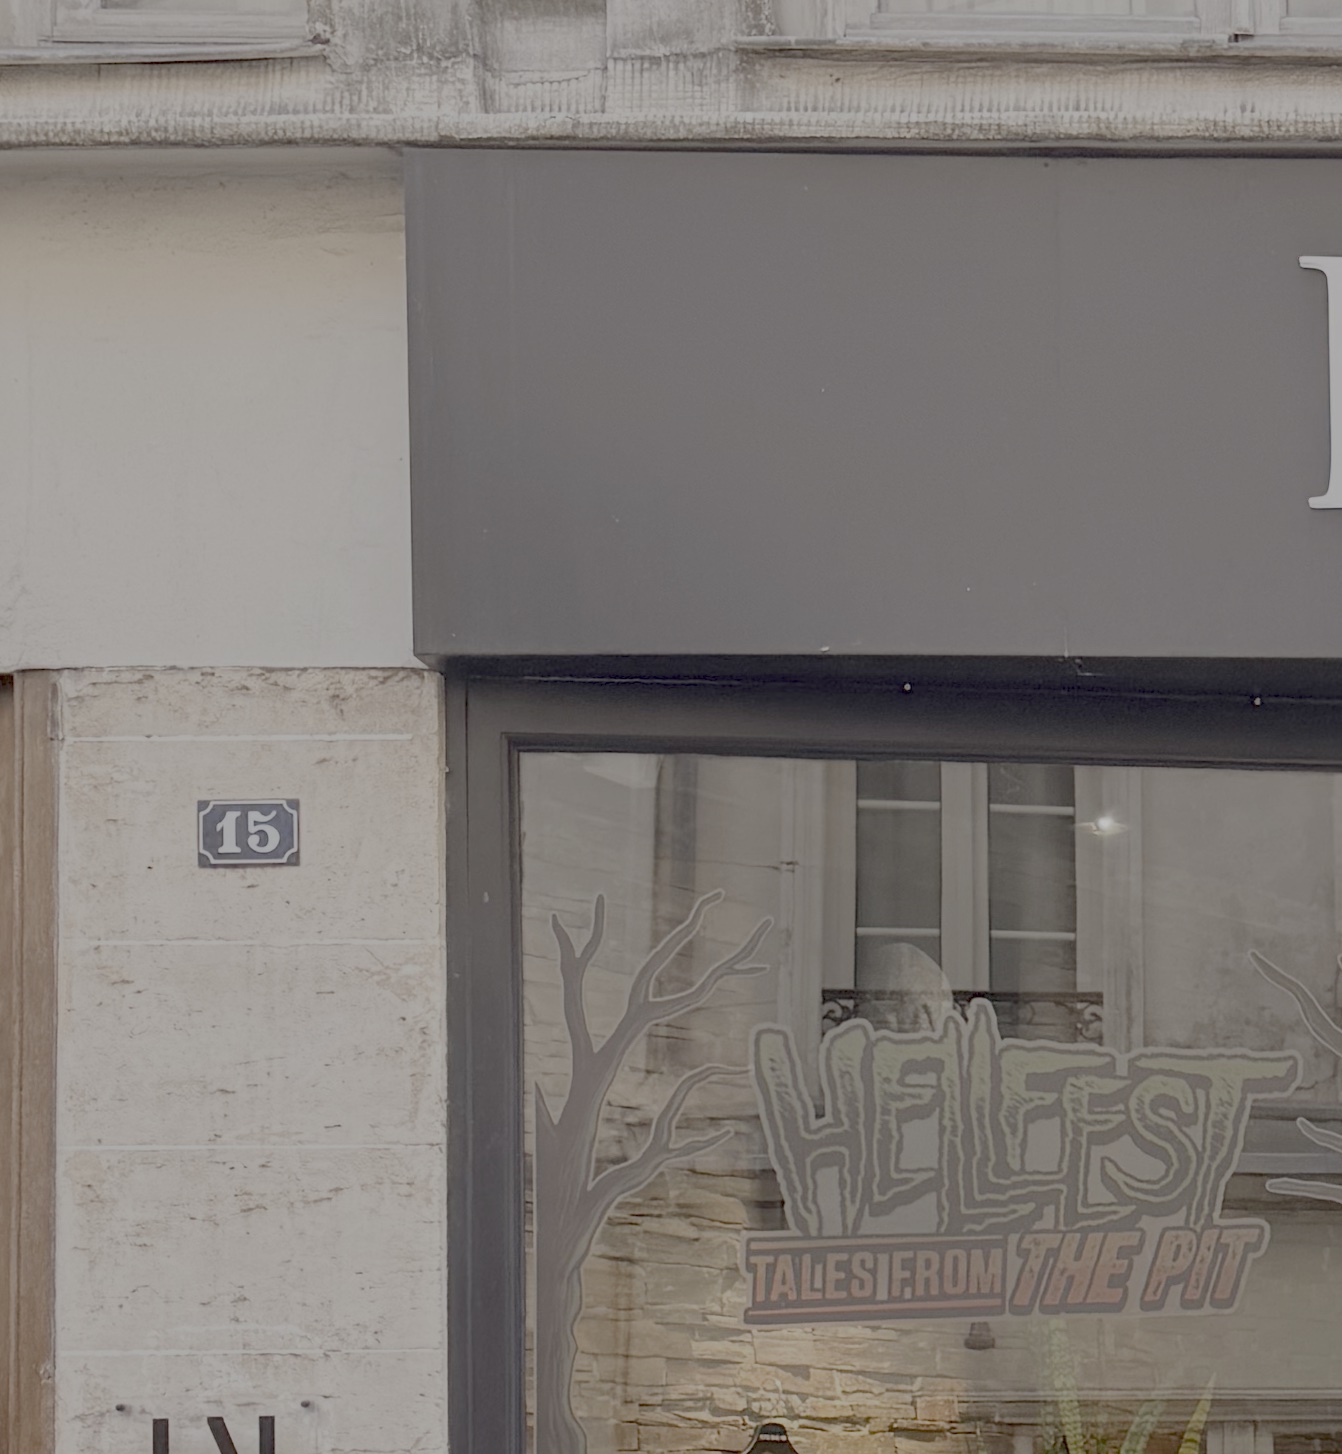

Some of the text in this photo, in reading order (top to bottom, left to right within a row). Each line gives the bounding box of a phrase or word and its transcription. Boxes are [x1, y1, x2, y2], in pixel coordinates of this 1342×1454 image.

[216, 810, 280, 854] 15
[753, 998, 1300, 1238] HELLFEST
[749, 1226, 1262, 1313] TALES FROM THE PIT
